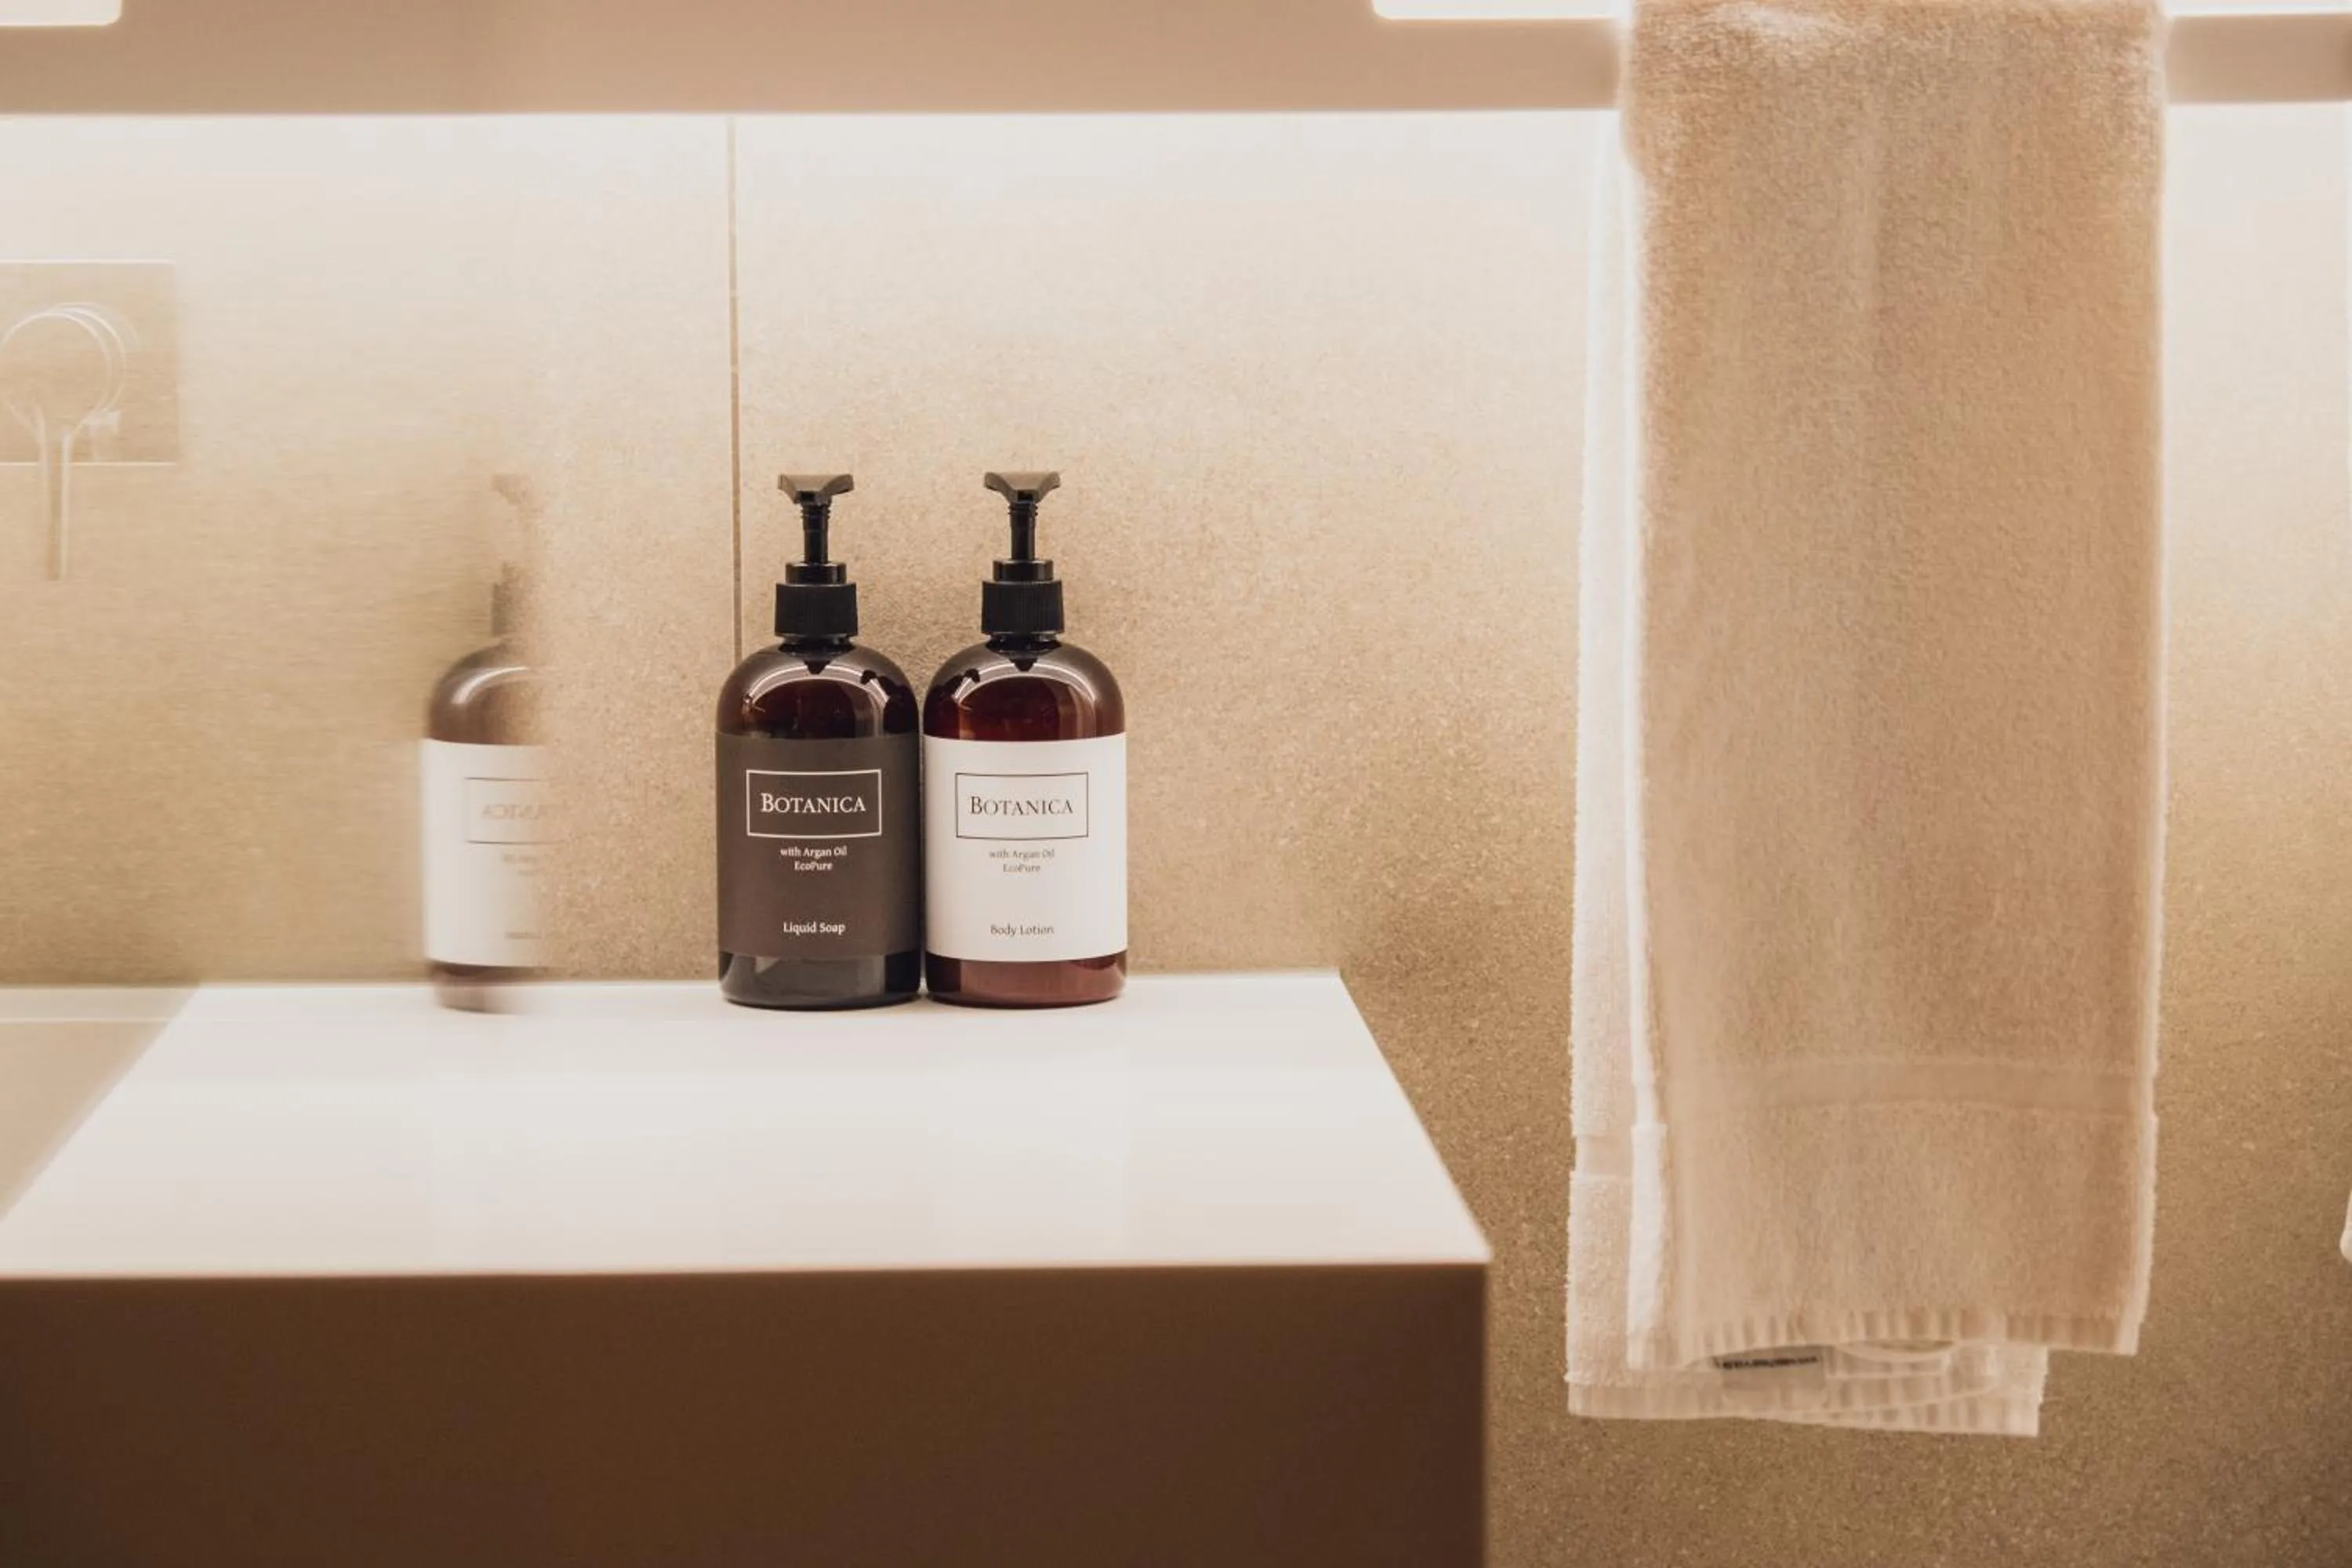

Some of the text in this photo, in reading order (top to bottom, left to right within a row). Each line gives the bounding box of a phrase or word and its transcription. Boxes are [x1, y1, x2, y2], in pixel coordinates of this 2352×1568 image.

[760, 793, 866, 814] BOTANICA
[970, 795, 1074, 816] BOTANICA
[780, 845, 848, 859] with Argan Oil
[989, 848, 1054, 862] with Argan Oil
[794, 861, 833, 871] EcoPure
[1003, 863, 1041, 873] EcoPure
[783, 921, 846, 935] Liquid Soap
[990, 923, 1054, 938] Body Lotion
